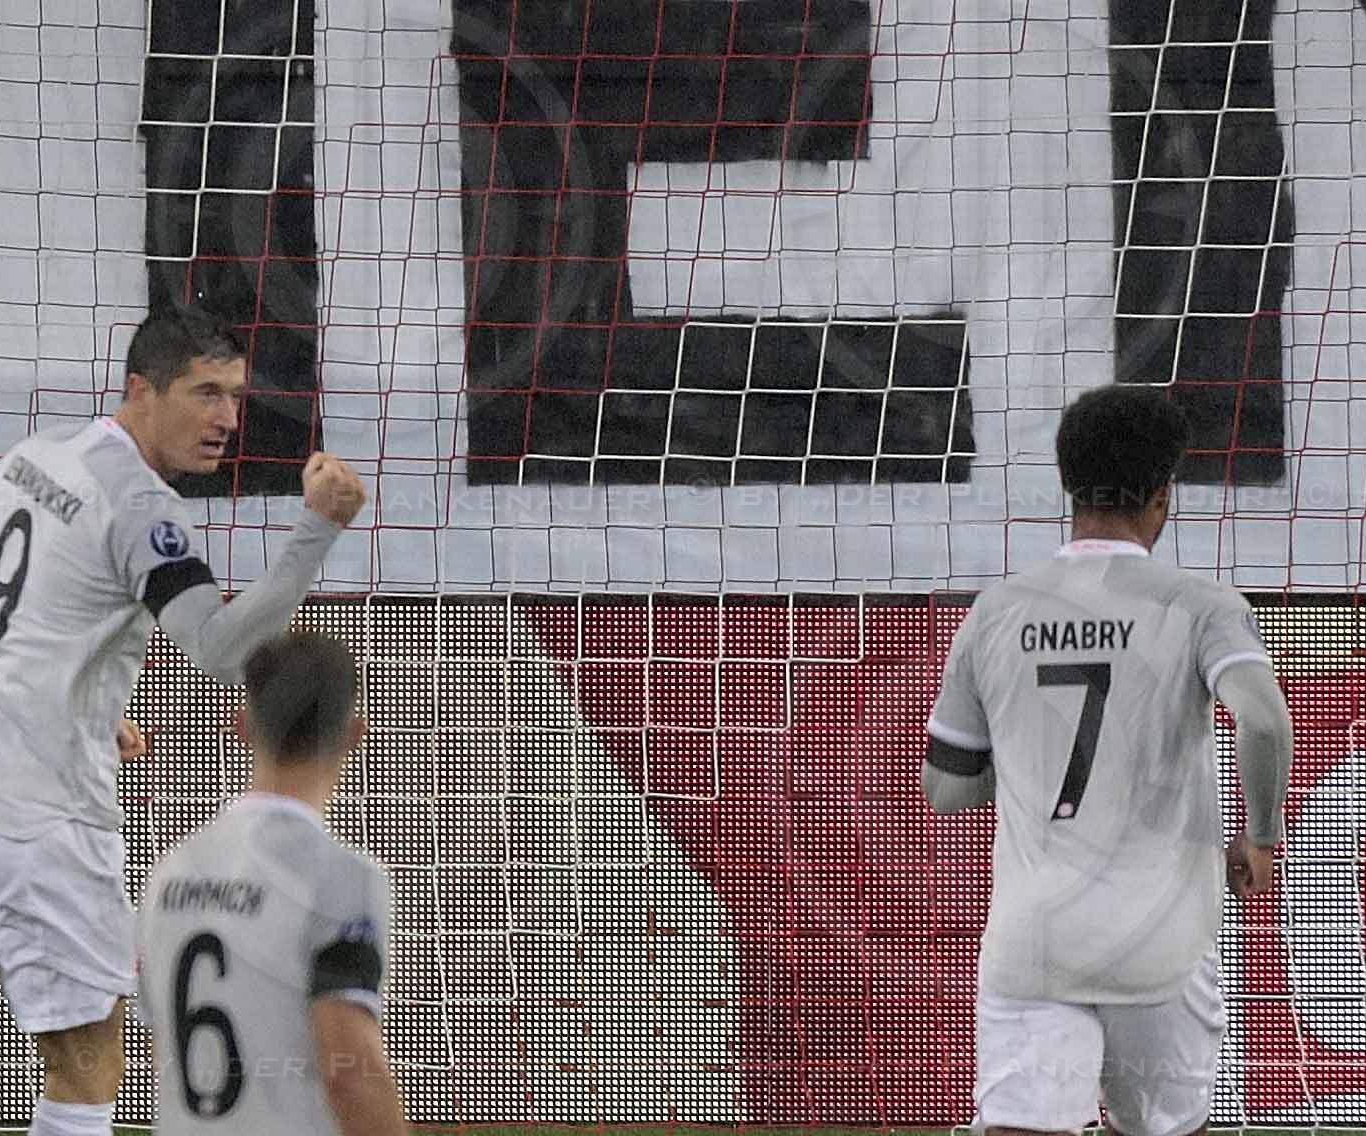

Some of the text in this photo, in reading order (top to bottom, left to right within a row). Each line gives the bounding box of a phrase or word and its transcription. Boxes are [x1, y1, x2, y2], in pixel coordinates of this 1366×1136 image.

[1020, 619, 1135, 652] GNABRY
[1036, 662, 1111, 822] 7
[174, 932, 243, 1120] 6
